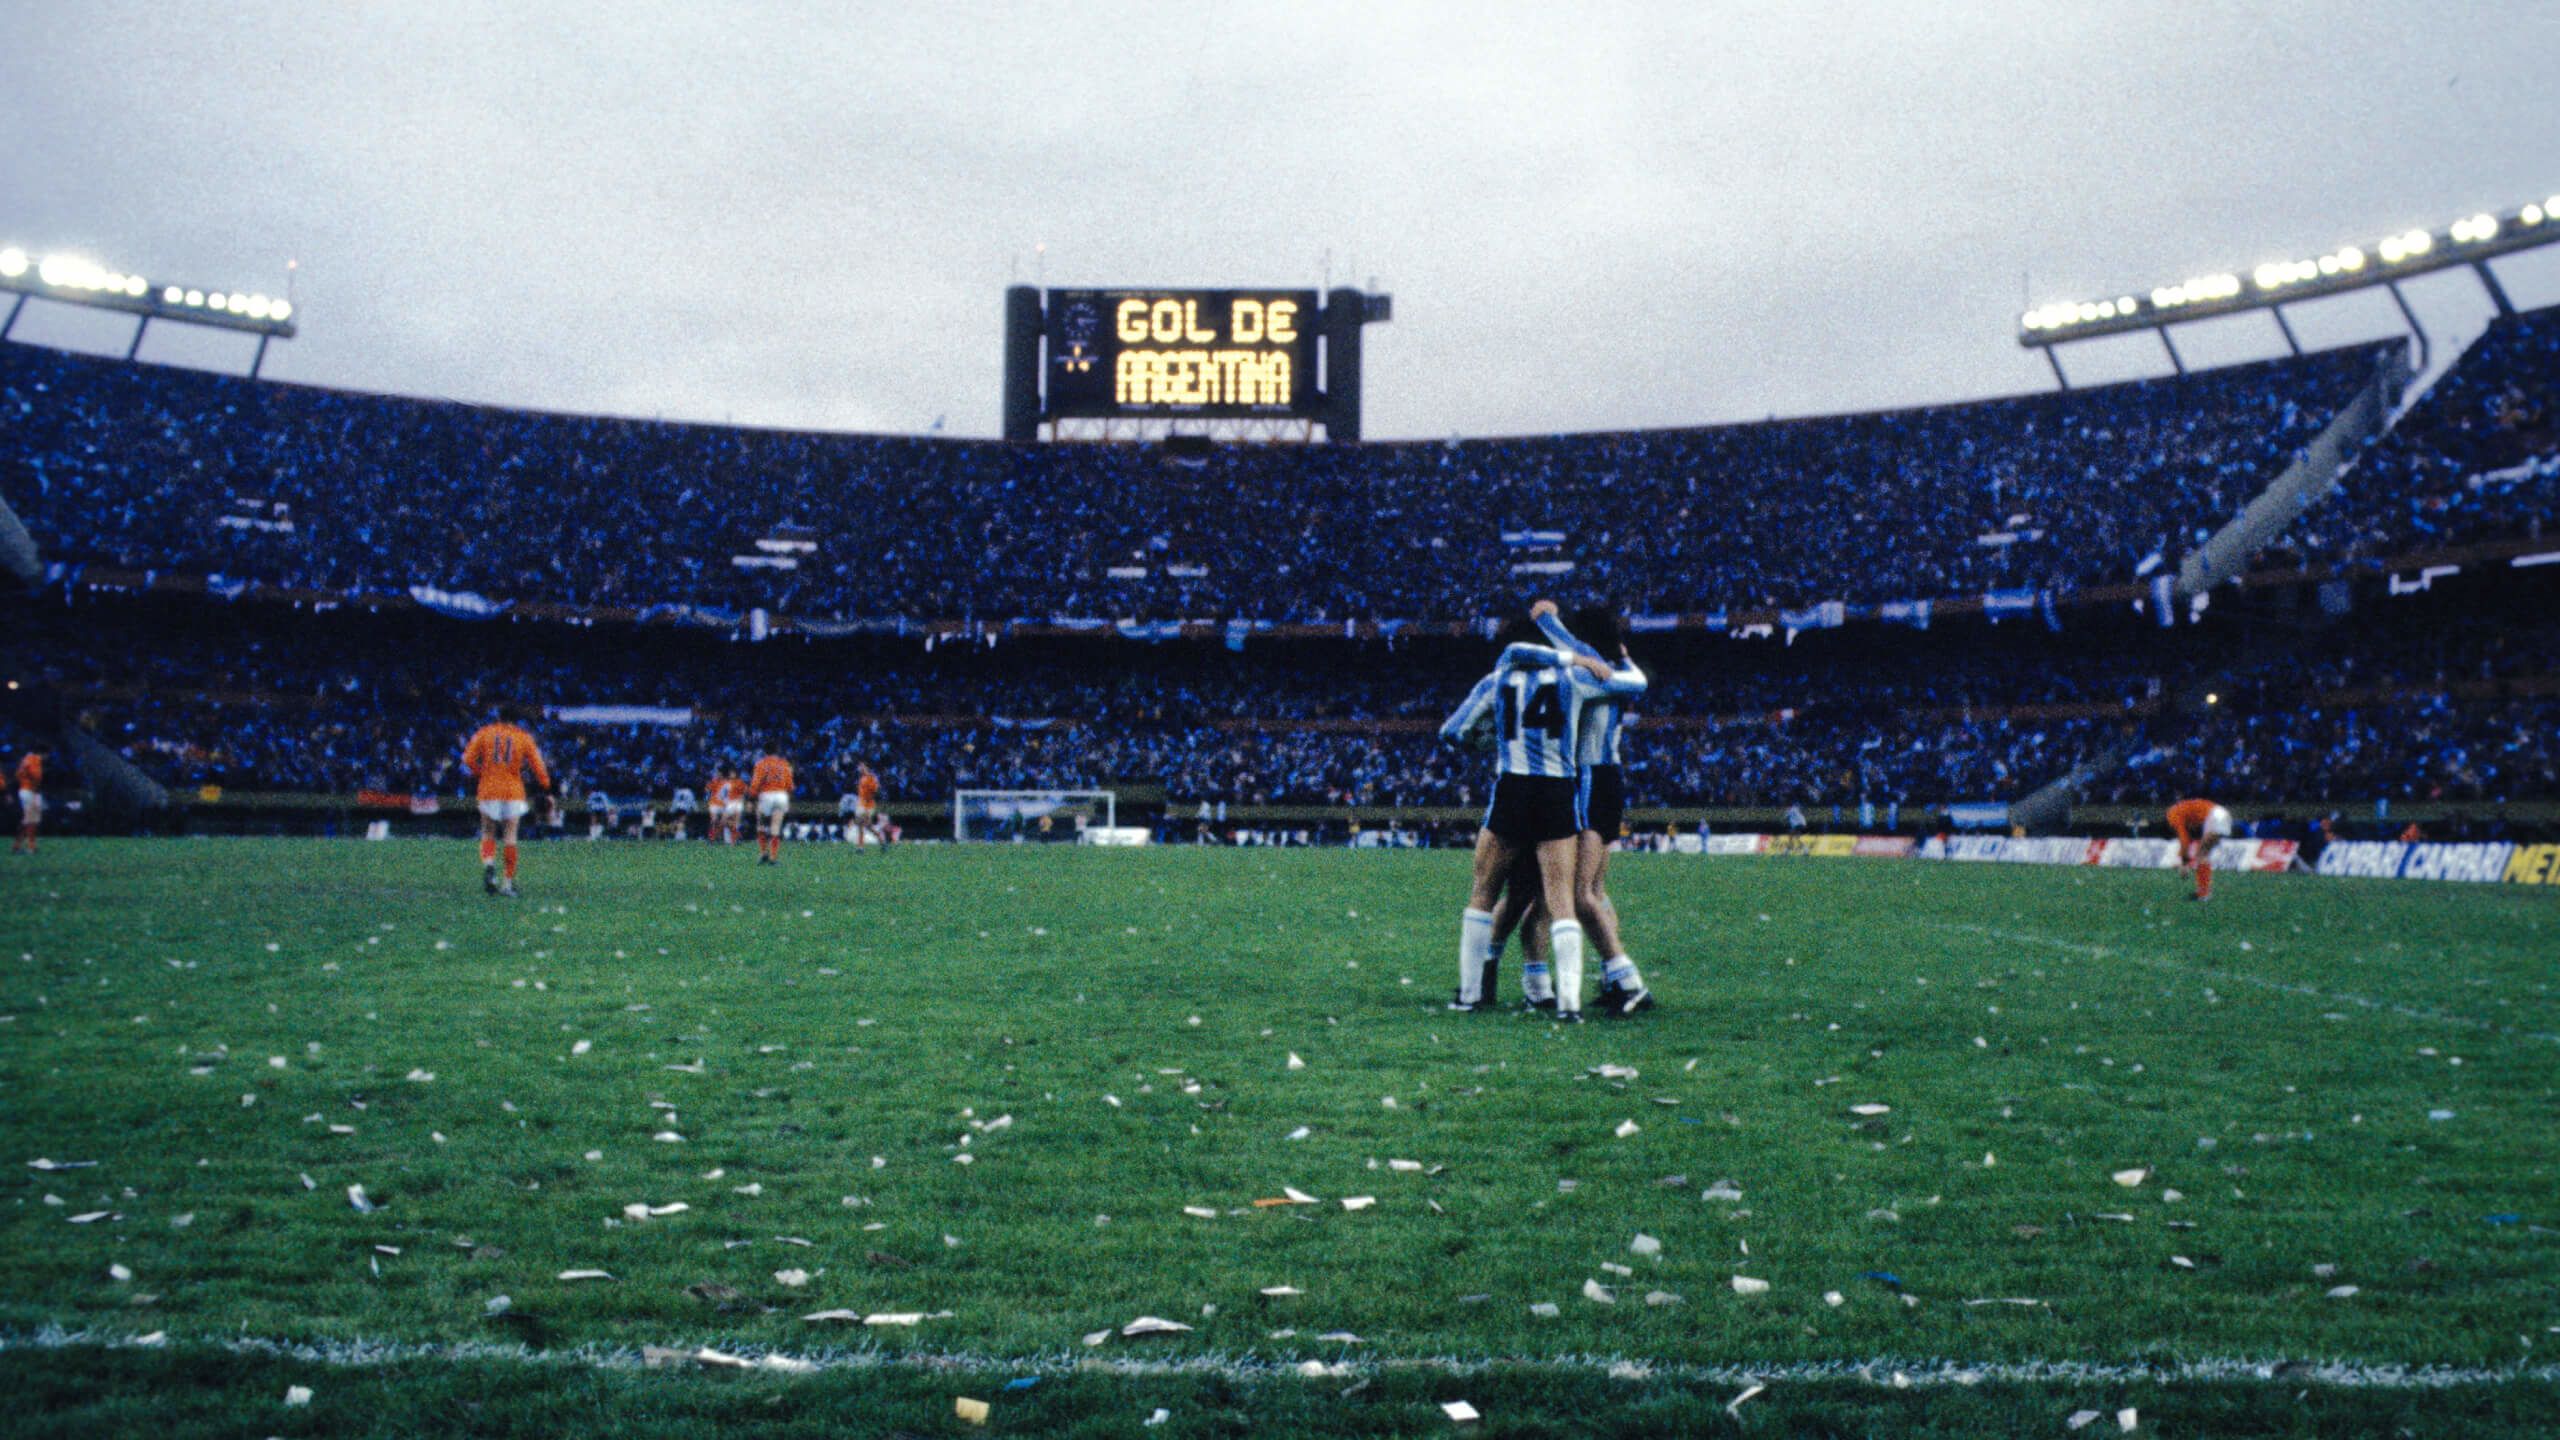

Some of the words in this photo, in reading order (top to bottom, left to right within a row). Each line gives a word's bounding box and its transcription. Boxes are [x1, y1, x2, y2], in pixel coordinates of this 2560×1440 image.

[1116, 298, 1217, 344] GOL
[1231, 298, 1298, 344] DE
[1115, 349, 1292, 405] ARGENTINA
[1502, 682, 1566, 741] 14
[493, 736, 513, 765] 11
[2317, 840, 2409, 879] CAMPARI
[2404, 840, 2513, 883] CAMPARI
[2503, 843, 2560, 885] MET
